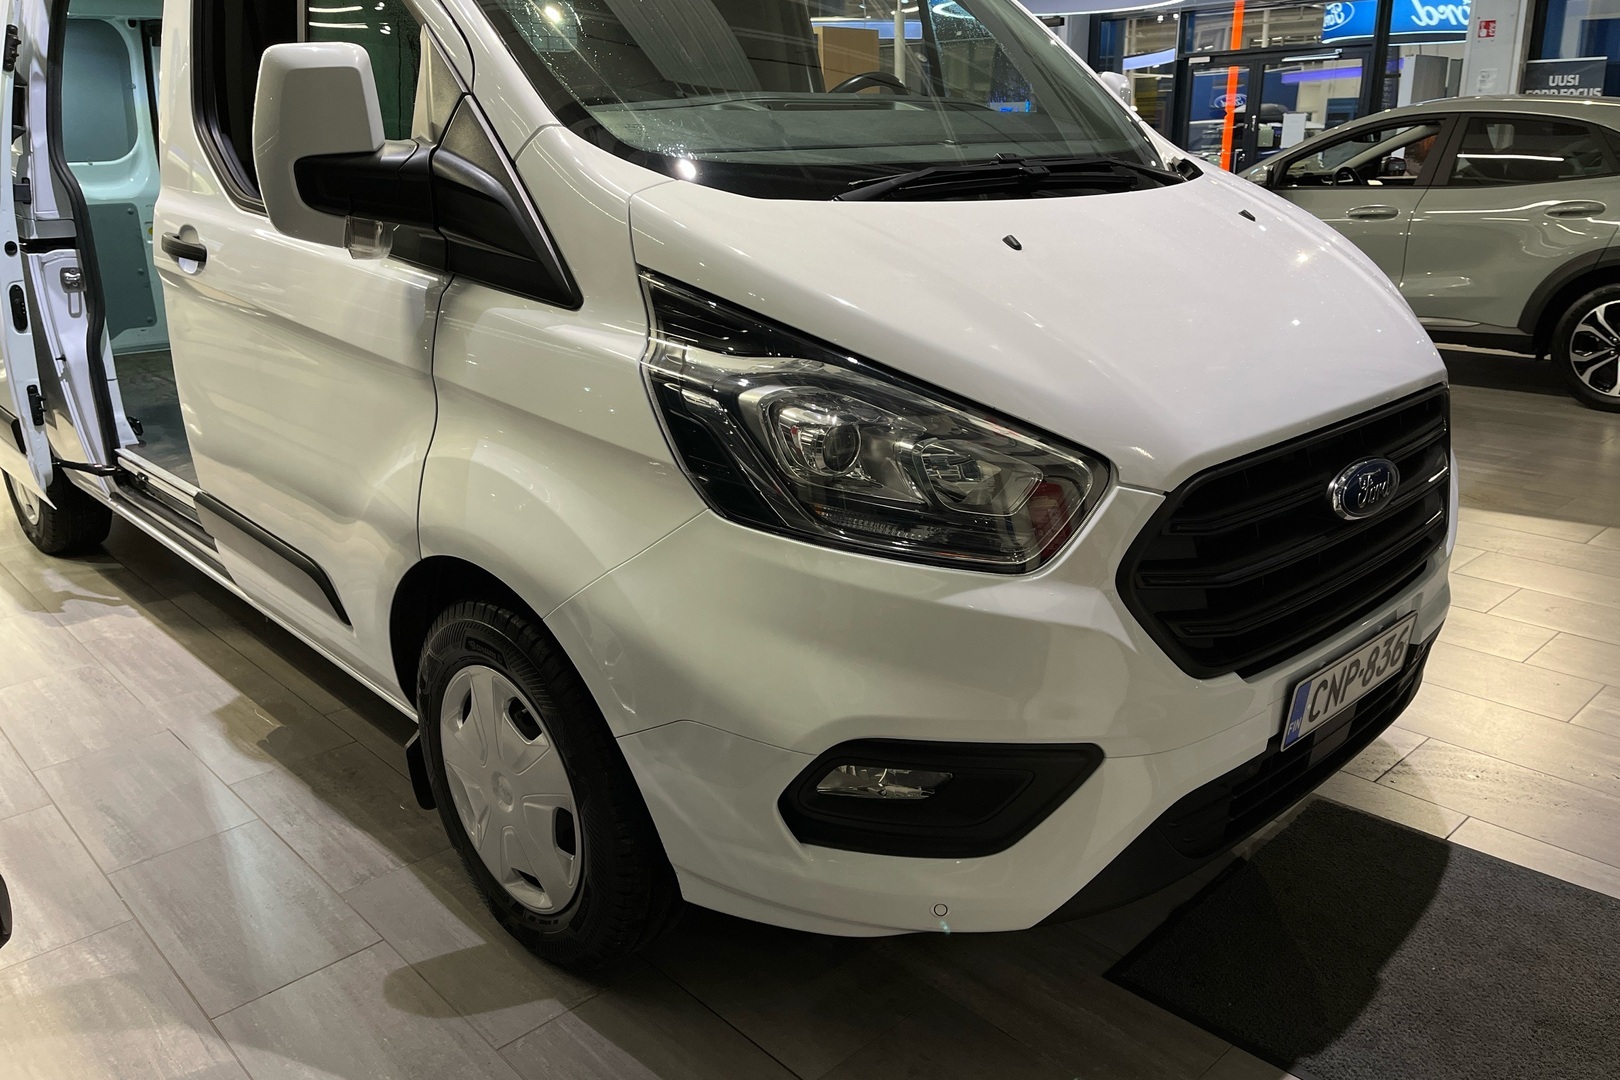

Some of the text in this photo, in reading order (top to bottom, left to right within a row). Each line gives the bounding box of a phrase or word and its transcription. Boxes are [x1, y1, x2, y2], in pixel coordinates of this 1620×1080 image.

[1548, 74, 1580, 87] UUSI
[1357, 467, 1391, 509] Ford
[1308, 624, 1410, 723] CNP-836
[1287, 716, 1302, 736] FIN
